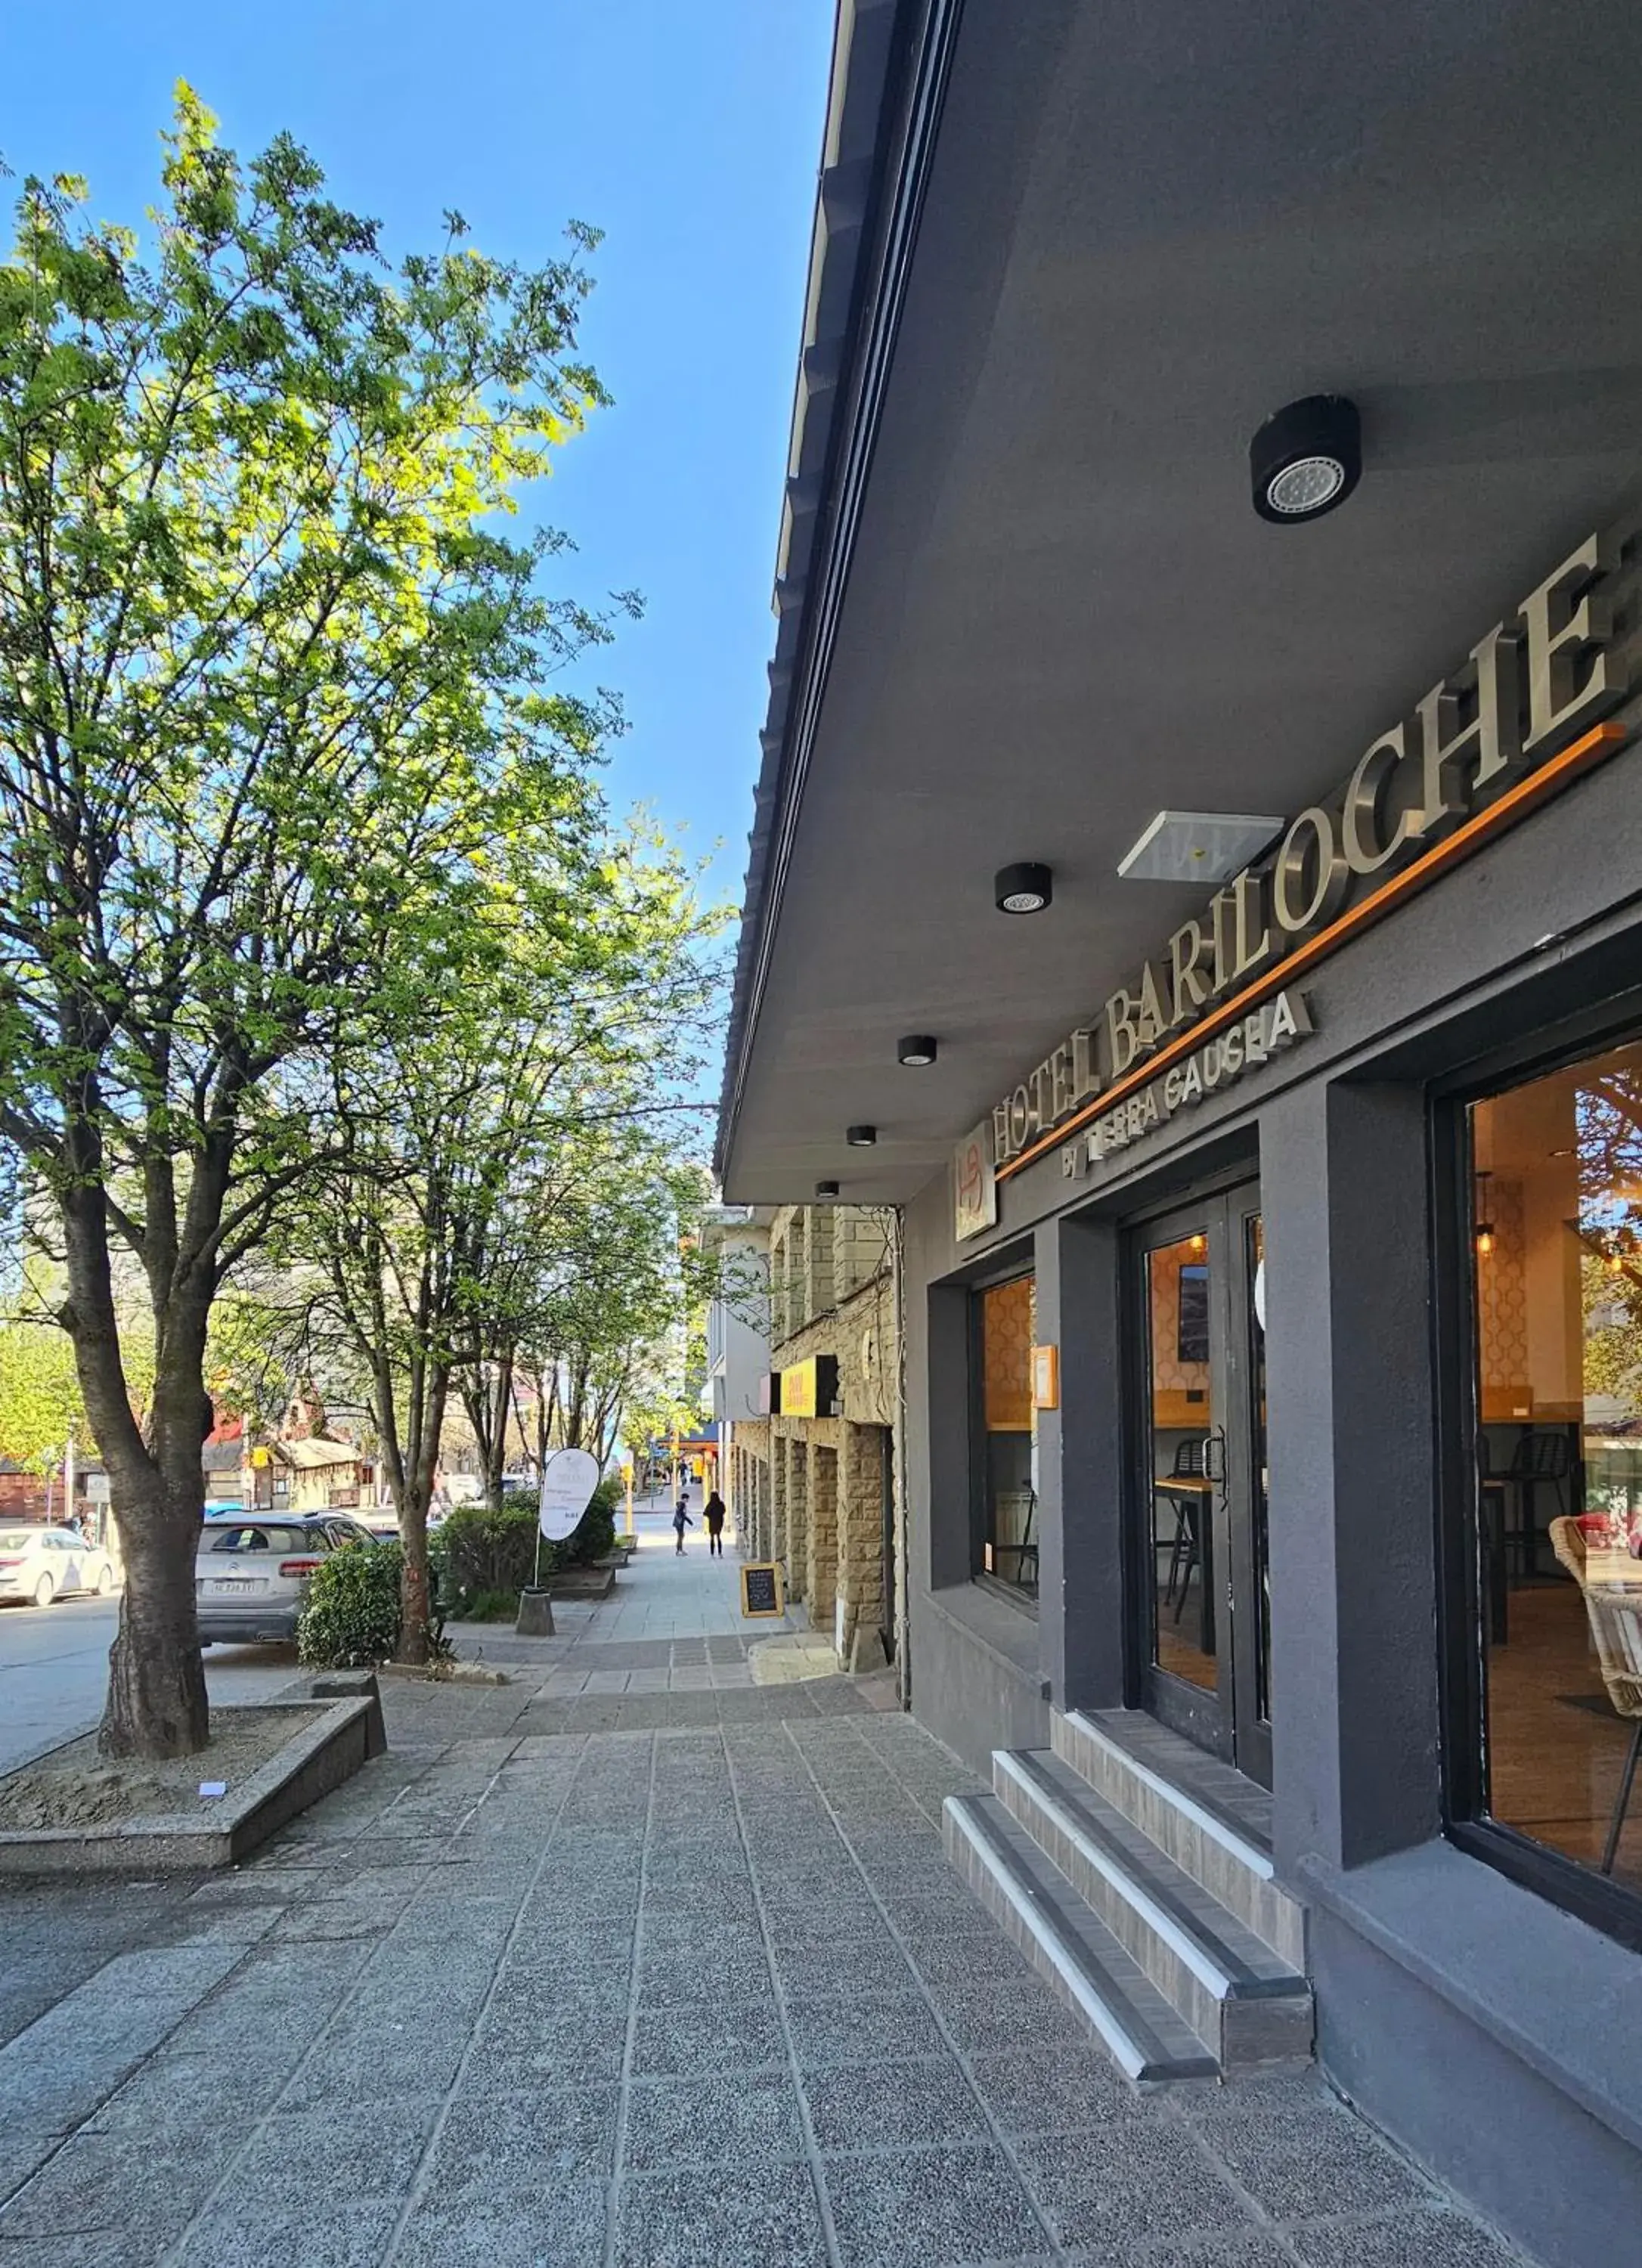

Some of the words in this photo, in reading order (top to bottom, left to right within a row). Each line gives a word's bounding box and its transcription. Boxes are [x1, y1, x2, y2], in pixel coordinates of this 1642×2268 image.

[993, 1029, 1098, 1168] HOTEL
[1104, 532, 1607, 1080] BARILOCHE
[1164, 991, 1298, 1111] GAUCHA
